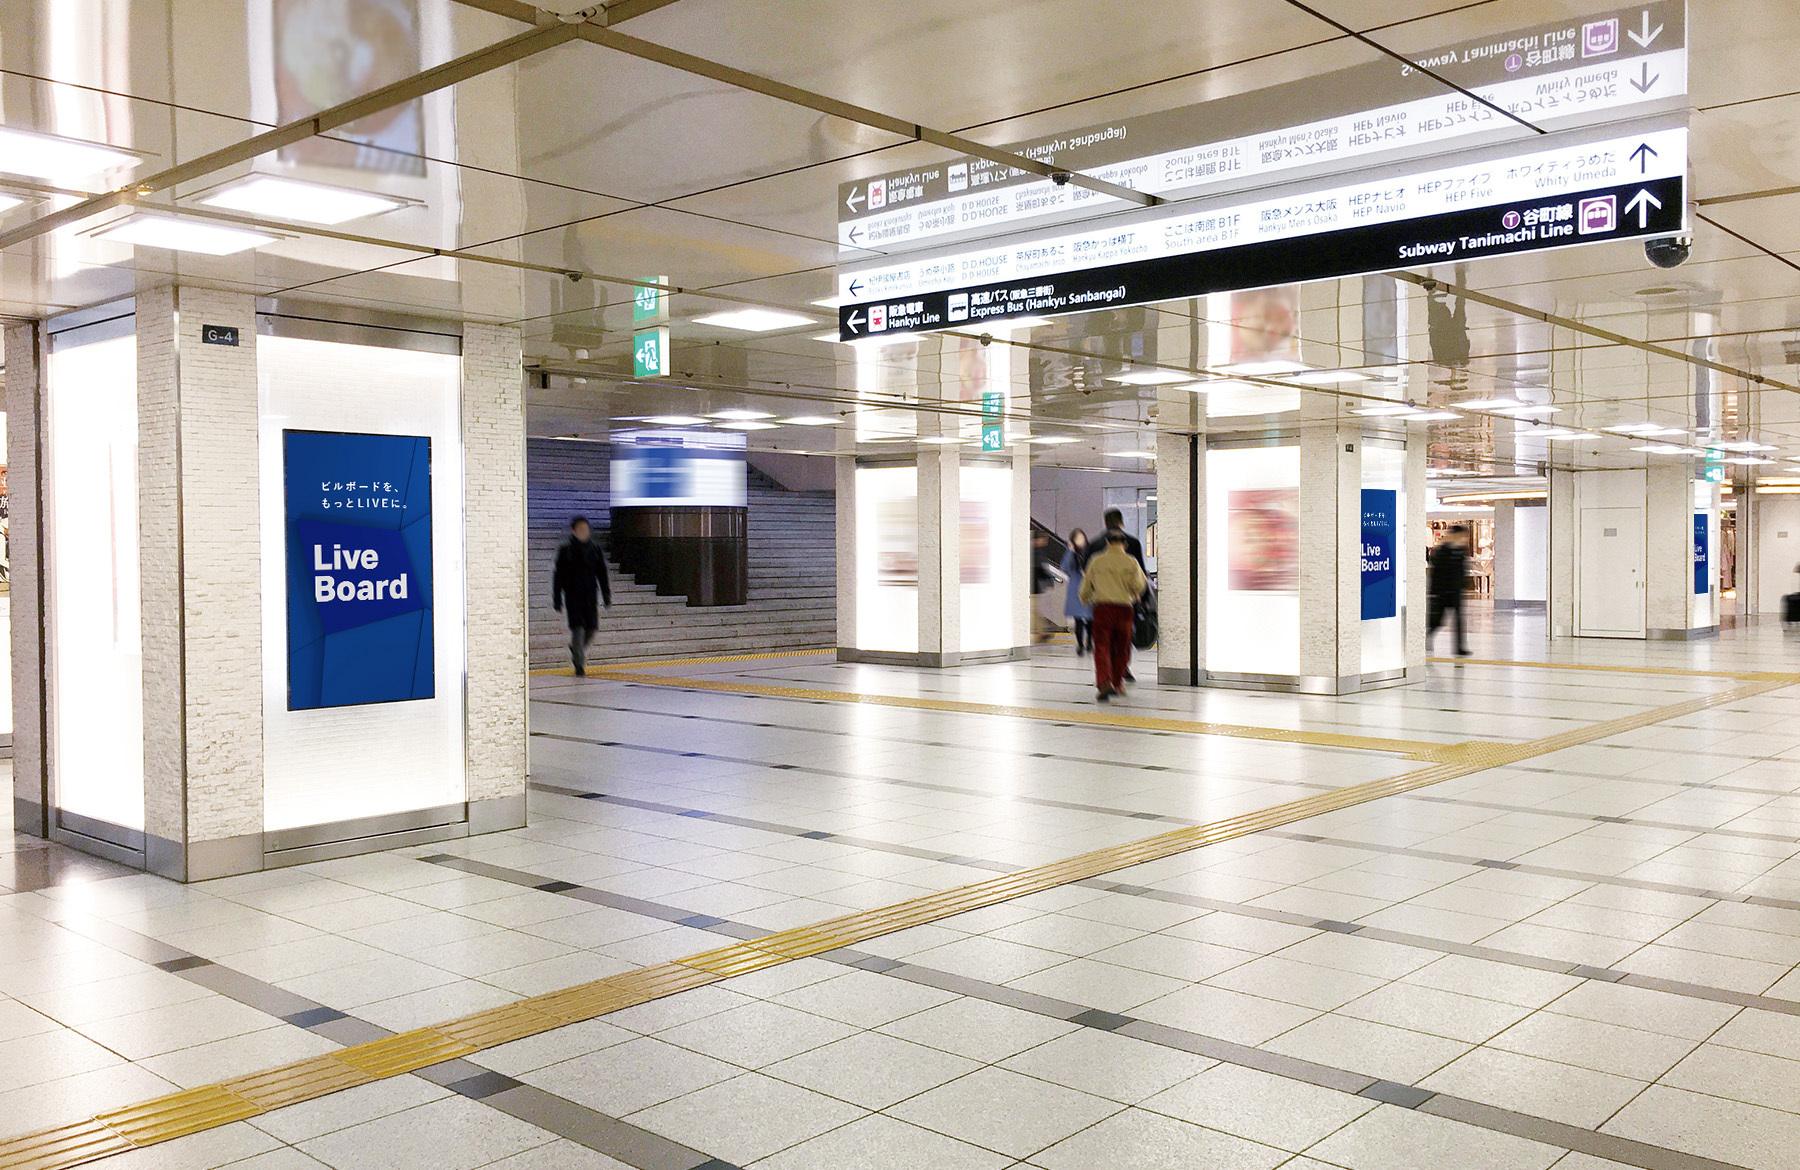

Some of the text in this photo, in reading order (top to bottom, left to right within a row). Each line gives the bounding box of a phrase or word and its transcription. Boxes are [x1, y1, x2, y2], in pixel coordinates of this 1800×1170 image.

[1535, 167, 1616, 188] Whity Umeda
[1446, 187, 1493, 203] HEP Five
[1353, 202, 1406, 217] HEP Navio
[1523, 203, 1573, 226] 谷町線
[1165, 237, 1193, 249] South
[1196, 234, 1218, 244] area
[1399, 223, 1573, 259] Subway Tanimachi Line
[971, 286, 1126, 318] Express Bus (Hankyu Sanbangai)
[889, 312, 941, 328] Hankyu Line
[208, 329, 233, 343] G-4
[321, 481, 400, 493] ビルボードを、
[321, 497, 408, 509] もっとLIVEに。
[313, 544, 379, 571] Live
[1361, 543, 1381, 557] Live
[1361, 558, 1390, 572] Board
[314, 573, 408, 602] Board
